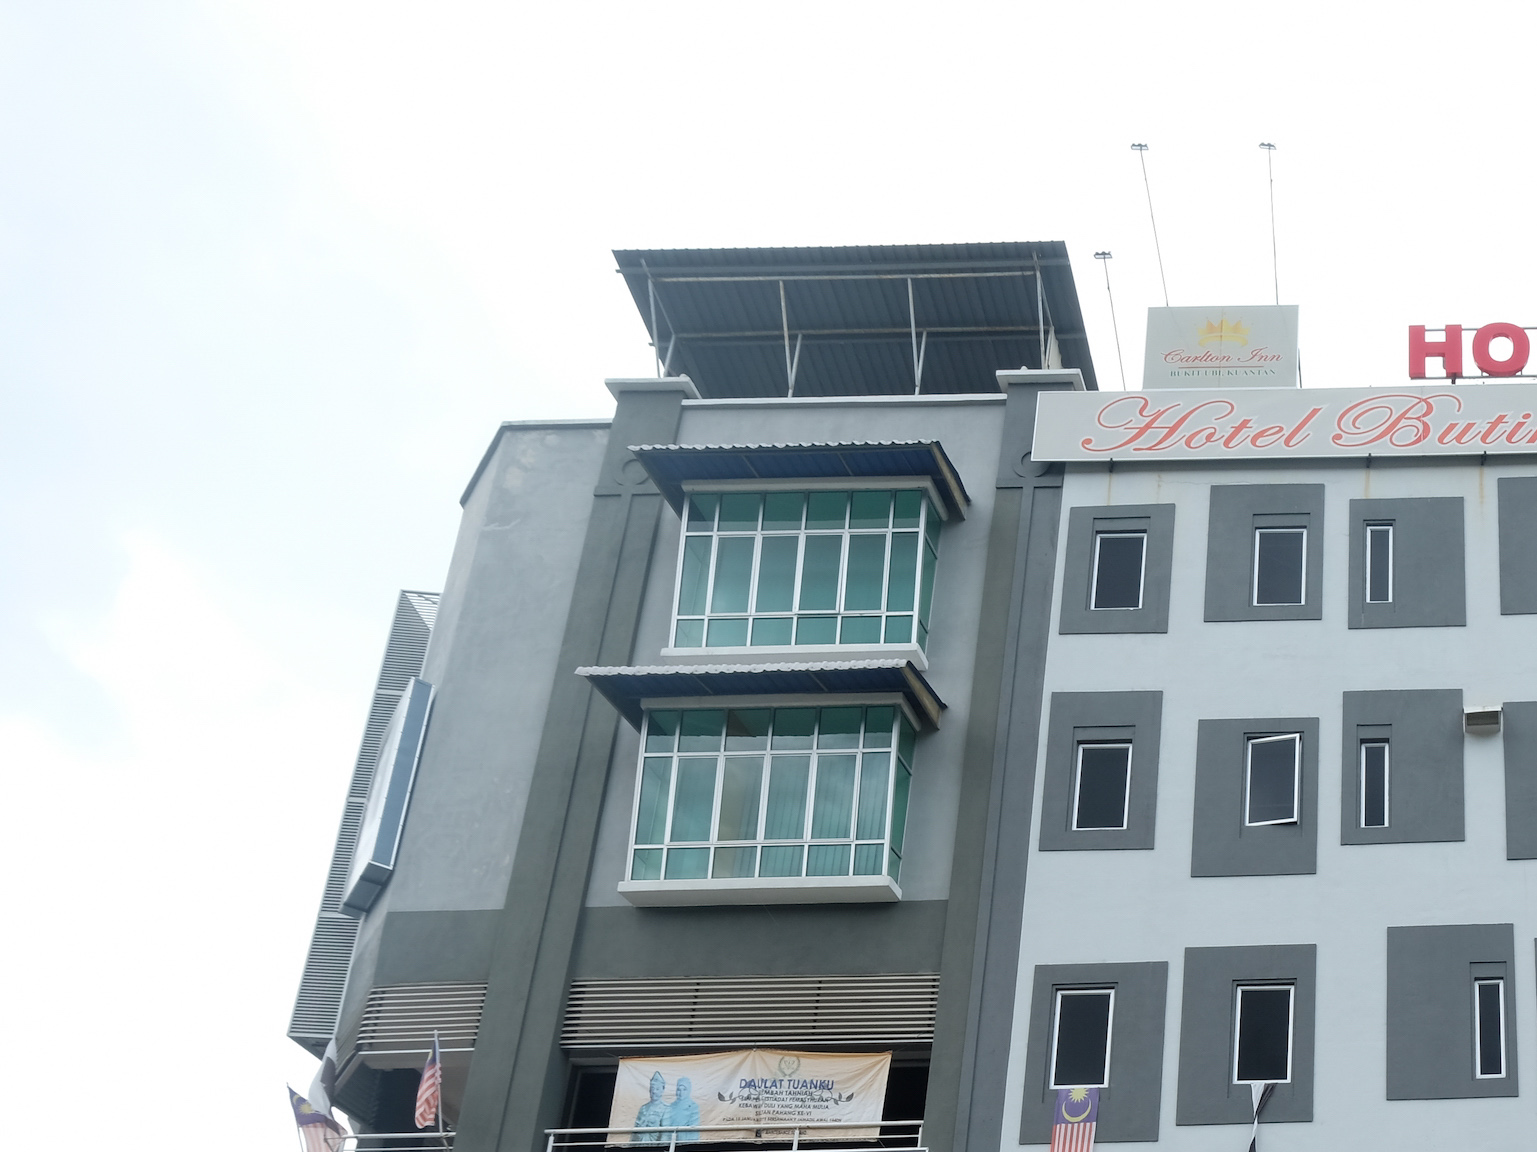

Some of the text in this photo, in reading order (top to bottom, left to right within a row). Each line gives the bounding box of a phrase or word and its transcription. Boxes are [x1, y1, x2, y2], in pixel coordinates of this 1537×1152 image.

[1161, 347, 1284, 364] Carlton Inn
[1081, 396, 1323, 452] Hotel
[739, 1078, 834, 1090] DAULAT TUANKU
